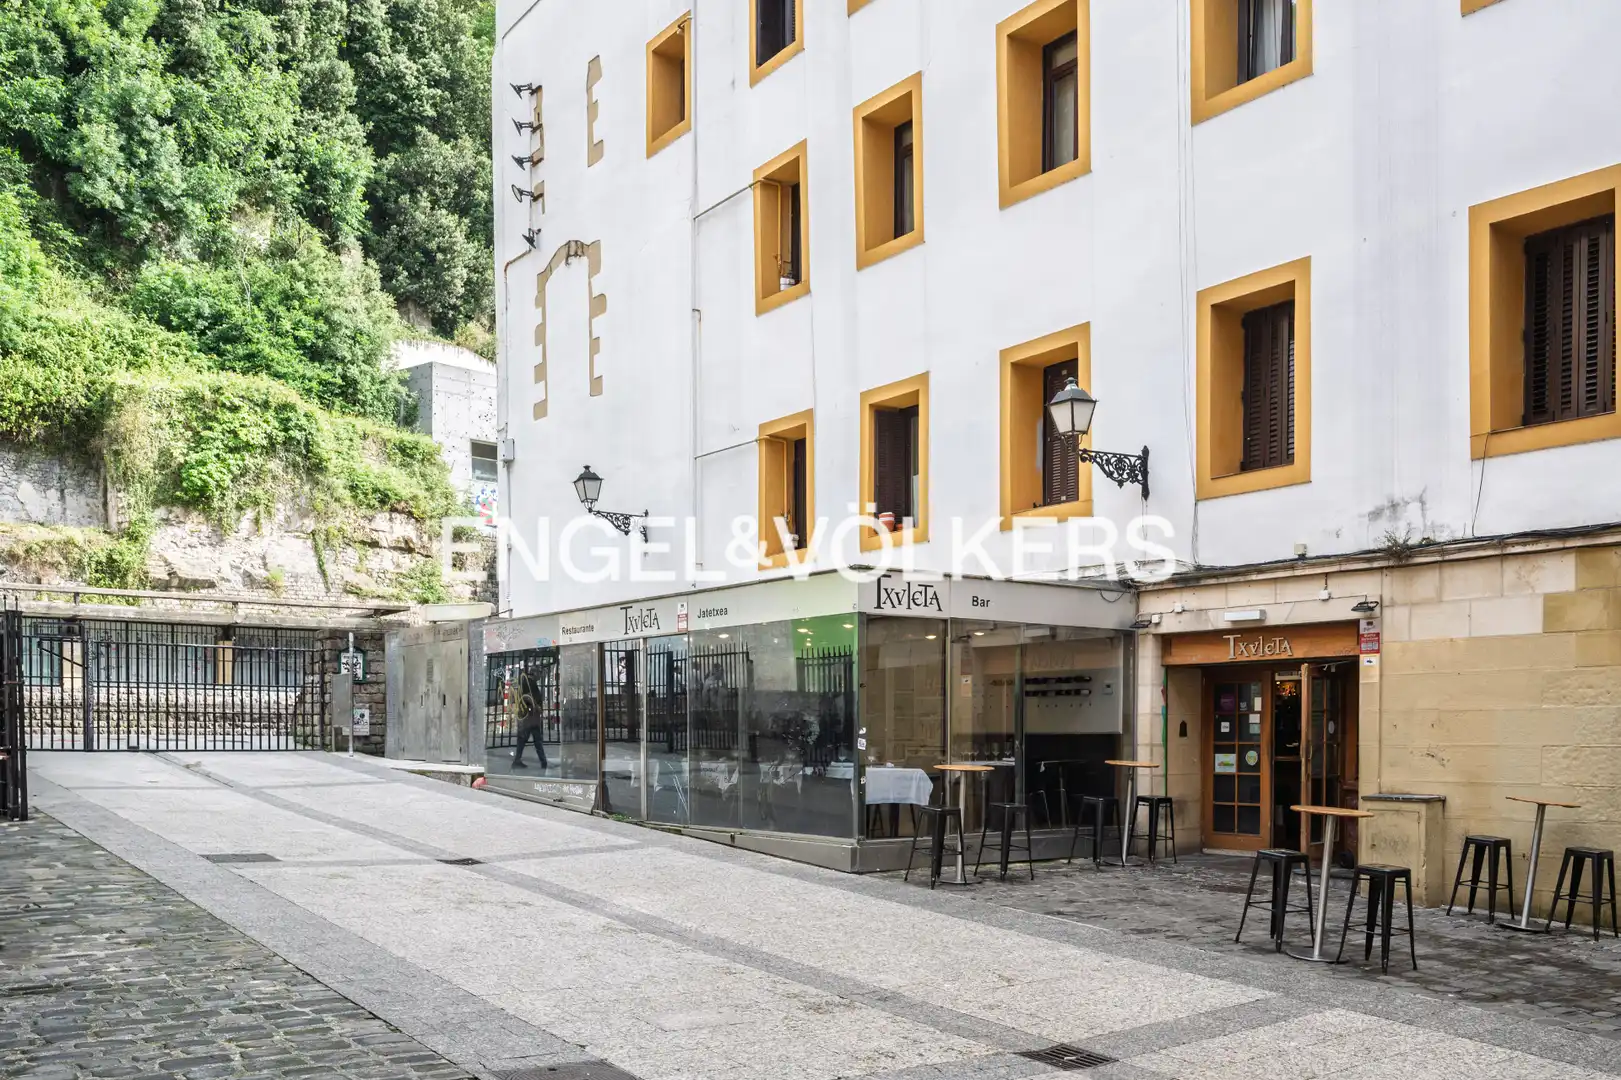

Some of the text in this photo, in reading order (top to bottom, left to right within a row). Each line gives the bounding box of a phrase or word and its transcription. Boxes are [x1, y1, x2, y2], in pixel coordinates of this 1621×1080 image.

[971, 595, 990, 608] Bar
[697, 607, 728, 619] Jatetxea
[561, 624, 595, 635] Restaurante
